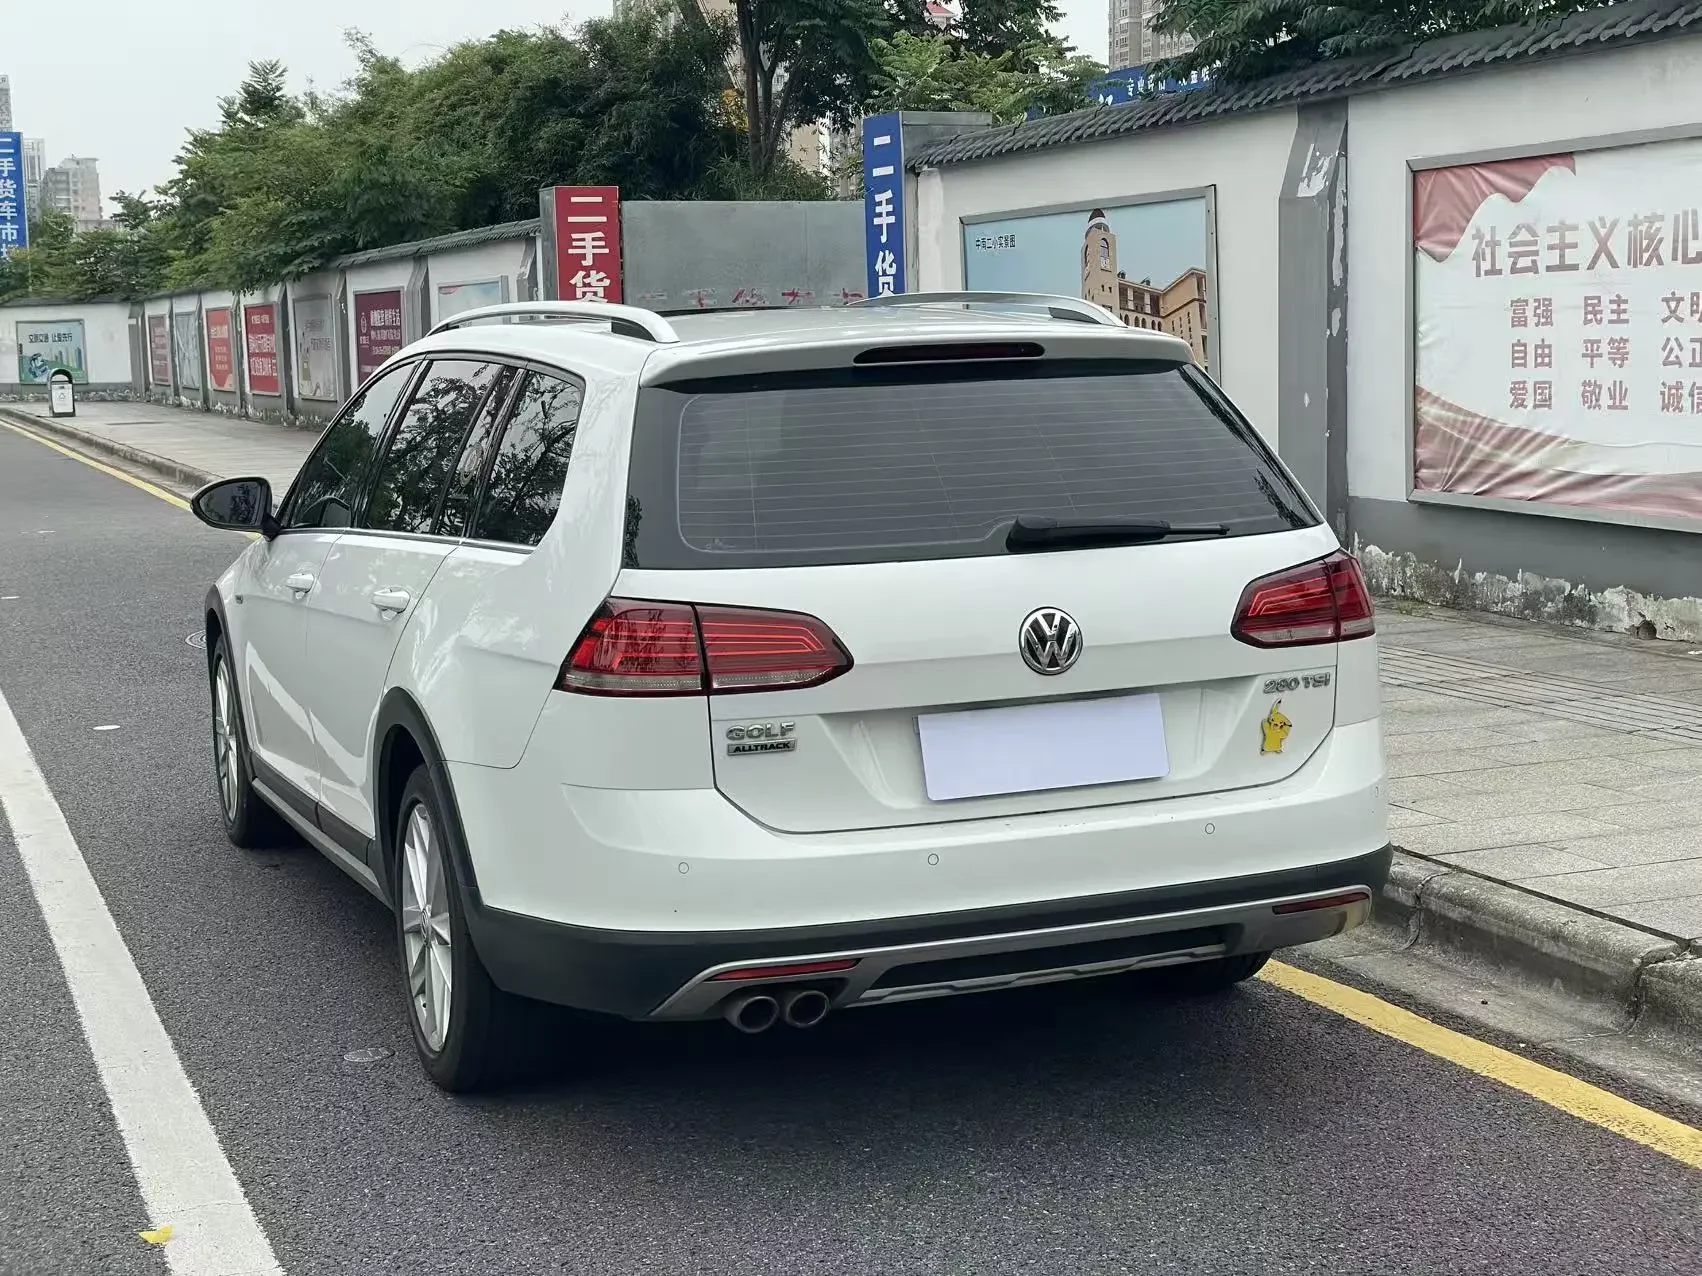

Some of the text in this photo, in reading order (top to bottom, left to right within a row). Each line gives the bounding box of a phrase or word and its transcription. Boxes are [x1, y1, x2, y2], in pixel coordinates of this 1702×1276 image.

[873, 135, 897, 297] 二手货
[568, 197, 611, 303] 二手货
[1471, 208, 1702, 278] 社会主义核心
[1510, 297, 1553, 328] 富强
[1583, 294, 1630, 326] 民主
[1511, 338, 1553, 369] 自由
[1581, 336, 1630, 369] 平等
[1509, 380, 1553, 410] 爱国
[1581, 380, 1629, 411] 敬业
[1263, 672, 1331, 694] 280 TSI
[726, 722, 795, 740] GOLF
[733, 742, 790, 753] ALLTRACK
